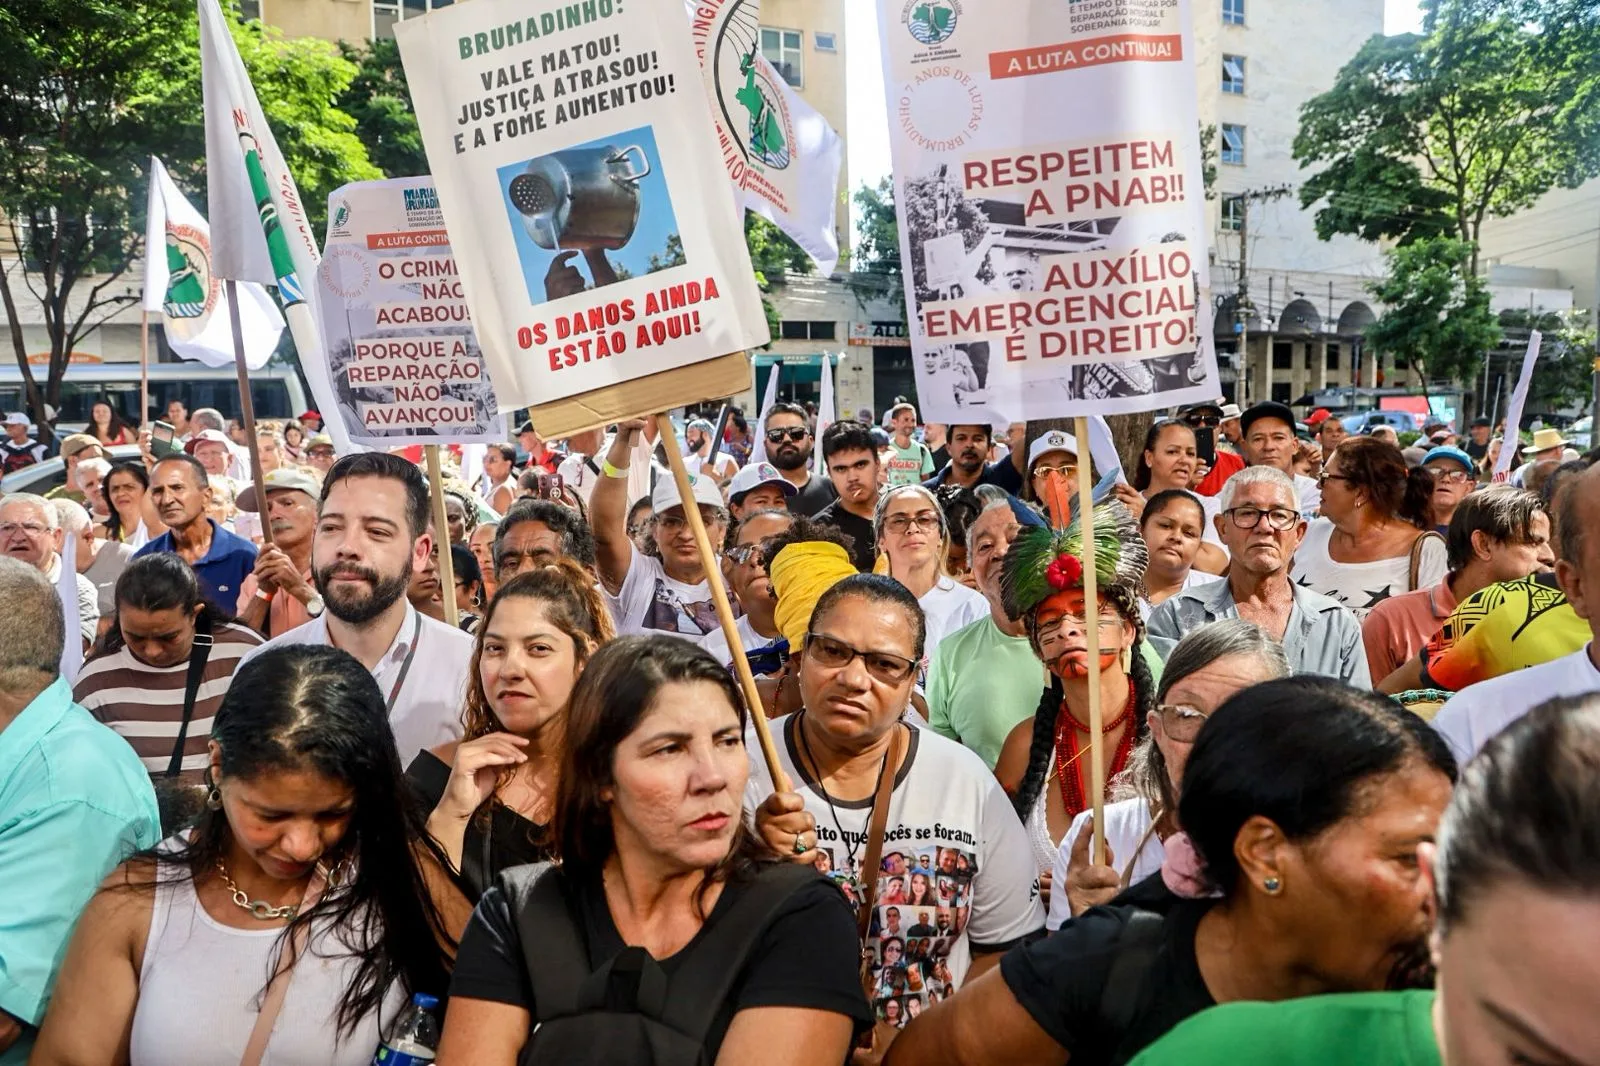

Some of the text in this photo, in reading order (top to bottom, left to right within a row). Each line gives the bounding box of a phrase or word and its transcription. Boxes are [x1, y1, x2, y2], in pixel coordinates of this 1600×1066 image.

[1070, 8, 1128, 24] REPARAÇÃO
[1078, 0, 1112, 13] TEMPO
[458, 0, 624, 60] BRUMADINHO:
[1071, 18, 1127, 34] SOBERANIA
[481, 34, 621, 91] VALE MATOU!
[1008, 41, 1172, 73] A LUTA CONTINUA!
[458, 51, 659, 125] JUSTIÇA ATRASOU!
[914, 66, 950, 85] ANOS
[953, 69, 971, 86] DE
[454, 74, 675, 154] E A FOME AUMENTOU!
[968, 85, 984, 131] LUTAS
[899, 97, 965, 152] BRUMADINHO
[963, 140, 1174, 190] RESPEITEM
[403, 187, 437, 200] MARIA
[1026, 174, 1185, 217] A PNAB!!
[377, 238, 385, 246] A
[388, 234, 412, 246] LUTA
[379, 263, 395, 279] O
[1043, 248, 1192, 292] AUXÍLIO
[376, 304, 471, 324] ACABOU!
[517, 277, 719, 349] OS DANOS AINDA
[925, 284, 1195, 338] EMERGENCIAL
[357, 341, 466, 360] PORQUE A
[548, 311, 701, 371] ESTÃO AQUI!
[1005, 317, 1195, 362] É DIREITO!
[348, 360, 480, 384] REPARAÇÃO
[396, 382, 440, 402] NÃO
[365, 407, 475, 427] AVANÇOU!
[815, 825, 837, 841] ito
[841, 831, 868, 847] que
[915, 828, 931, 839] se
[934, 823, 976, 846] foram.
